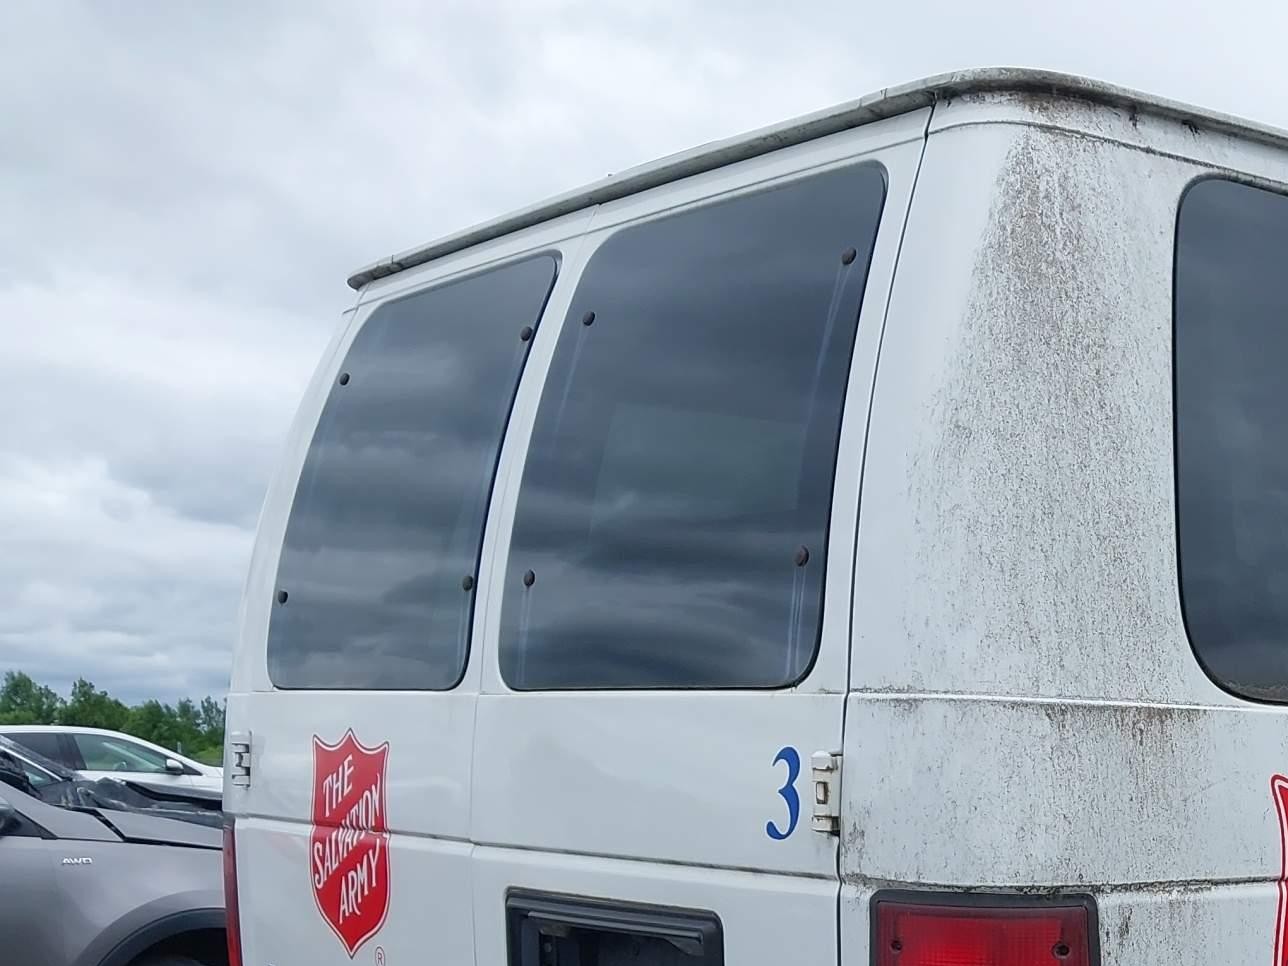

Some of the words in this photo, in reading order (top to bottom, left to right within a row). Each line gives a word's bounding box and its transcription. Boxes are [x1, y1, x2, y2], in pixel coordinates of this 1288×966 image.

[323, 754, 355, 817] THE
[765, 746, 801, 841] 3
[62, 857, 93, 865] AWD
[314, 773, 381, 889] SALVATION
[339, 839, 380, 924] ARMY
